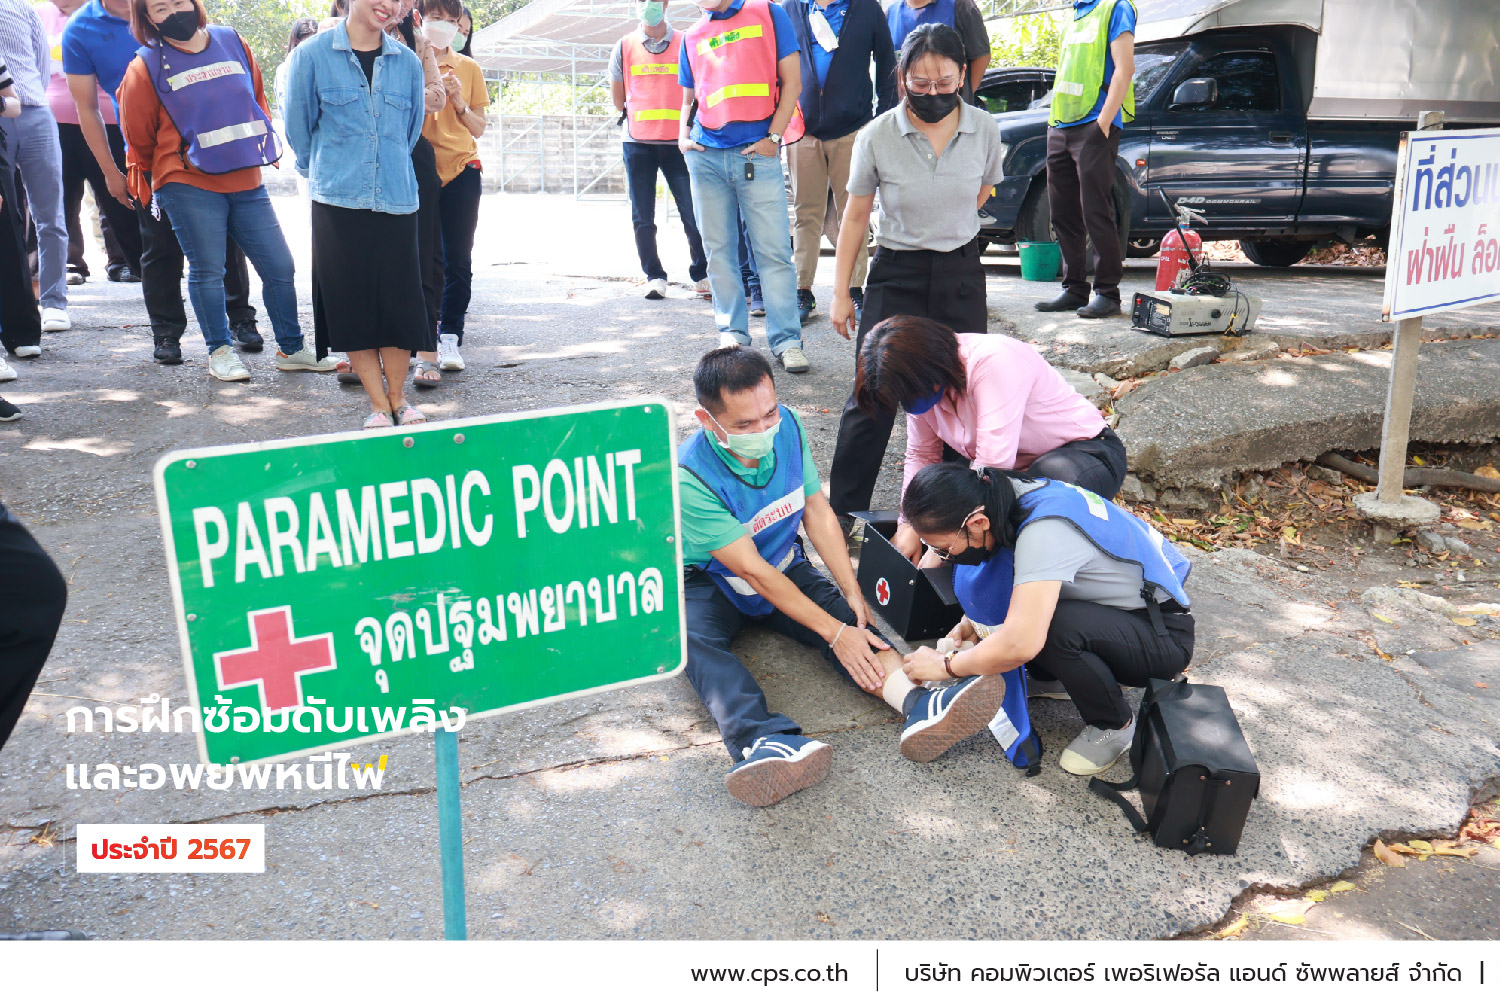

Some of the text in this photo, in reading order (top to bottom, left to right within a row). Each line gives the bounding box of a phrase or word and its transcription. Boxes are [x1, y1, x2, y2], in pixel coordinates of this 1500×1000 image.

[1471, 223, 1500, 276] ล็อ
[192, 449, 642, 588] PARAMEDIC POINT
[354, 565, 666, 695] จุดปฐมพยาบาล
